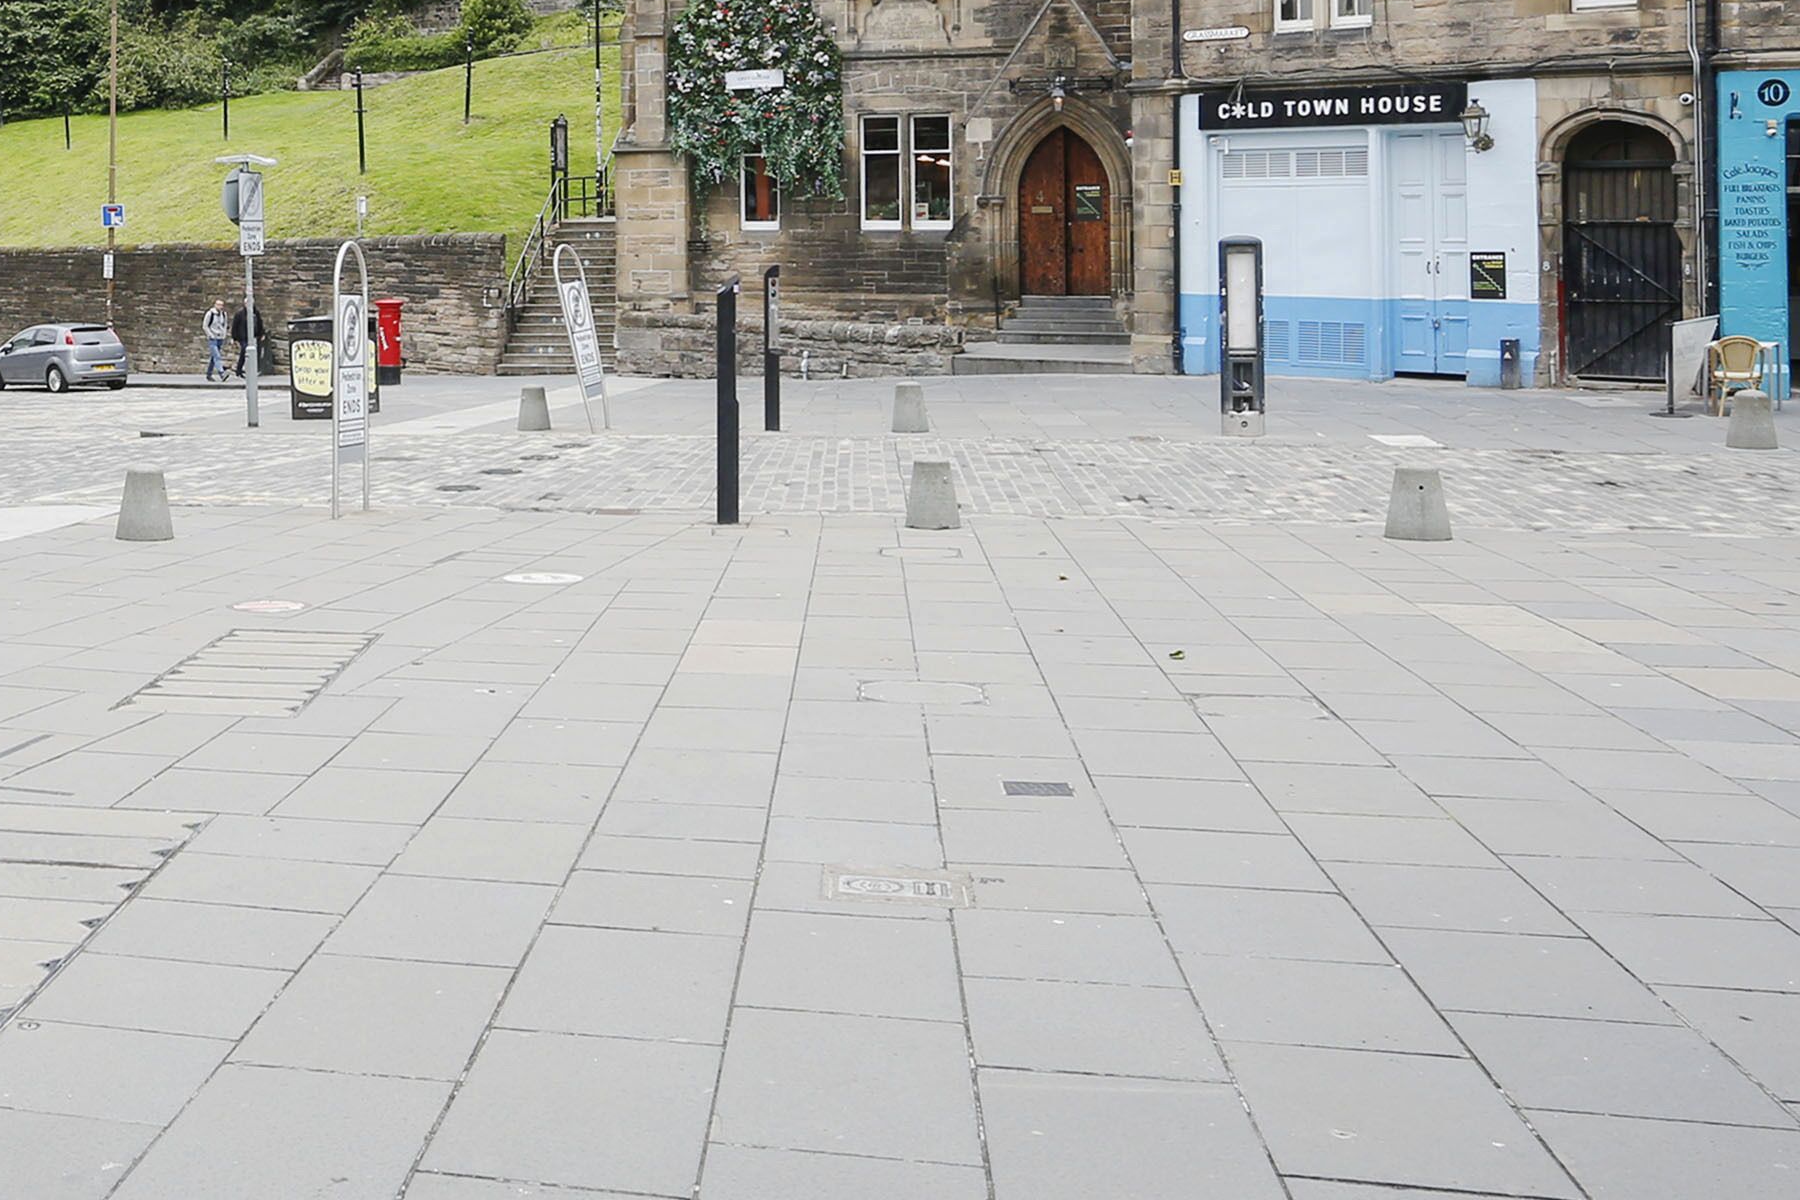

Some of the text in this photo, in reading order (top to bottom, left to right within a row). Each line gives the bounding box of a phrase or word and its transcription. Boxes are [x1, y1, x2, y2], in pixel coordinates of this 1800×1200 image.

[1186, 28, 1246, 39] GRASSMARKET
[1760, 83, 1784, 102] 10
[1283, 99, 1350, 117] TOWN
[1360, 95, 1442, 114] HOUSE
[1724, 185, 1740, 193] FULL
[1735, 207, 1770, 215] TOASTIES
[1724, 219, 1782, 227] BAKED POTATOES
[1736, 230, 1769, 238] SALADS
[243, 241, 262, 252] ENDS
[1728, 241, 1778, 250] FISH & CHIPS
[1736, 252, 1769, 261] BURGERS
[581, 351, 595, 364] ENDS
[342, 371, 361, 380] Pedestrian
[347, 383, 357, 394] Zone
[343, 400, 361, 414] ENDS
